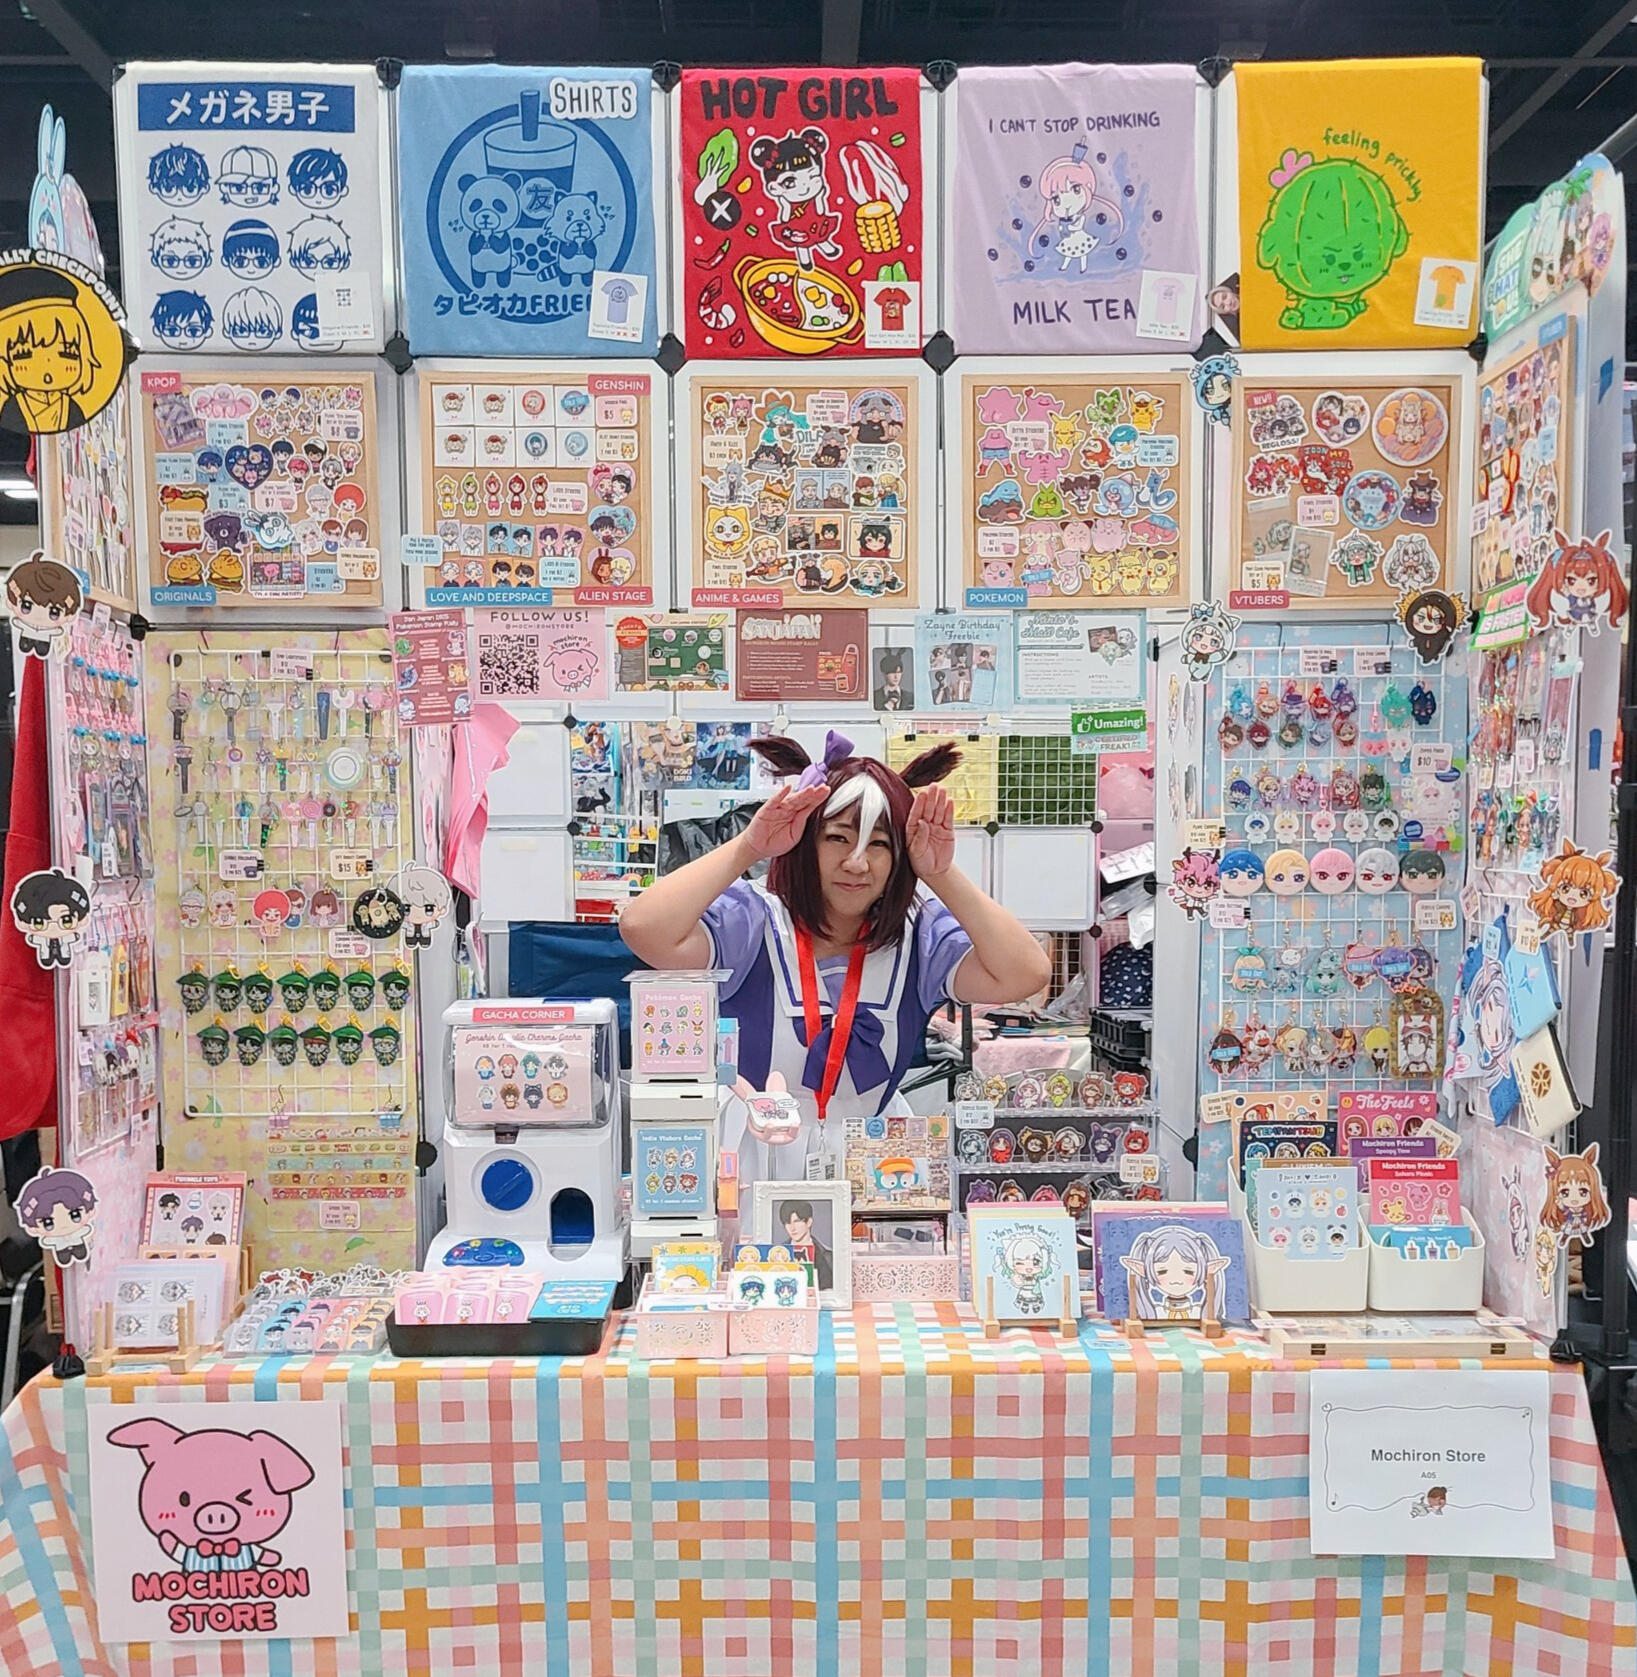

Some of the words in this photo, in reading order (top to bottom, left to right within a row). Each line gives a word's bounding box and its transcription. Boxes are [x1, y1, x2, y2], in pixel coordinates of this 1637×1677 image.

[554, 82, 632, 114] SHIRTS
[700, 77, 787, 120] HOT
[797, 77, 899, 120] GIRL
[166, 91, 329, 126] メガネ男子
[988, 118, 993, 133] I
[1000, 118, 1037, 133] CAN'T
[1044, 116, 1079, 133] STOP
[1086, 111, 1161, 131] DRINKING
[1322, 127, 1381, 159] feeling
[1384, 152, 1423, 203] prickly
[525, 183, 554, 212] 友
[35, 249, 127, 322] CHECKPOINT
[1013, 300, 1072, 325] MILK
[1083, 298, 1137, 322] TEA
[147, 377, 176, 388] KPOP
[595, 380, 645, 391] GENSHIN
[604, 409, 614, 420] $5
[1251, 579, 1261, 589] $5
[154, 591, 212, 602] ORIGINALS
[430, 592, 460, 602] LOVE
[462, 592, 483, 602] AND
[486, 592, 549, 602] DEEPSPACE
[578, 591, 609, 601] ALIEN
[611, 591, 646, 601] STAGE
[695, 593, 730, 603] ANIME
[732, 593, 740, 603] &
[742, 593, 780, 603] GAMES
[969, 593, 1024, 603] POKEMON
[1234, 595, 1284, 605] VTUBERS
[490, 611, 556, 622] FOLLOW
[563, 610, 589, 622] US!
[924, 619, 955, 631] Zayne
[957, 618, 1001, 632] Birthday
[944, 631, 981, 641] Freebie
[1094, 716, 1144, 729] Umazing!
[1417, 757, 1431, 766] $10
[338, 863, 351, 872] $15
[482, 1010, 519, 1019] GACHA
[521, 1010, 565, 1019] CORNER
[1356, 1094, 1381, 1109] The
[1380, 1094, 1415, 1110] Feels
[1418, 1162, 1446, 1170] Friends
[1371, 1449, 1441, 1462] Mochiron
[1446, 1449, 1486, 1462] Store
[132, 1568, 310, 1602] MOCHIRON
[168, 1602, 278, 1634] STORE
